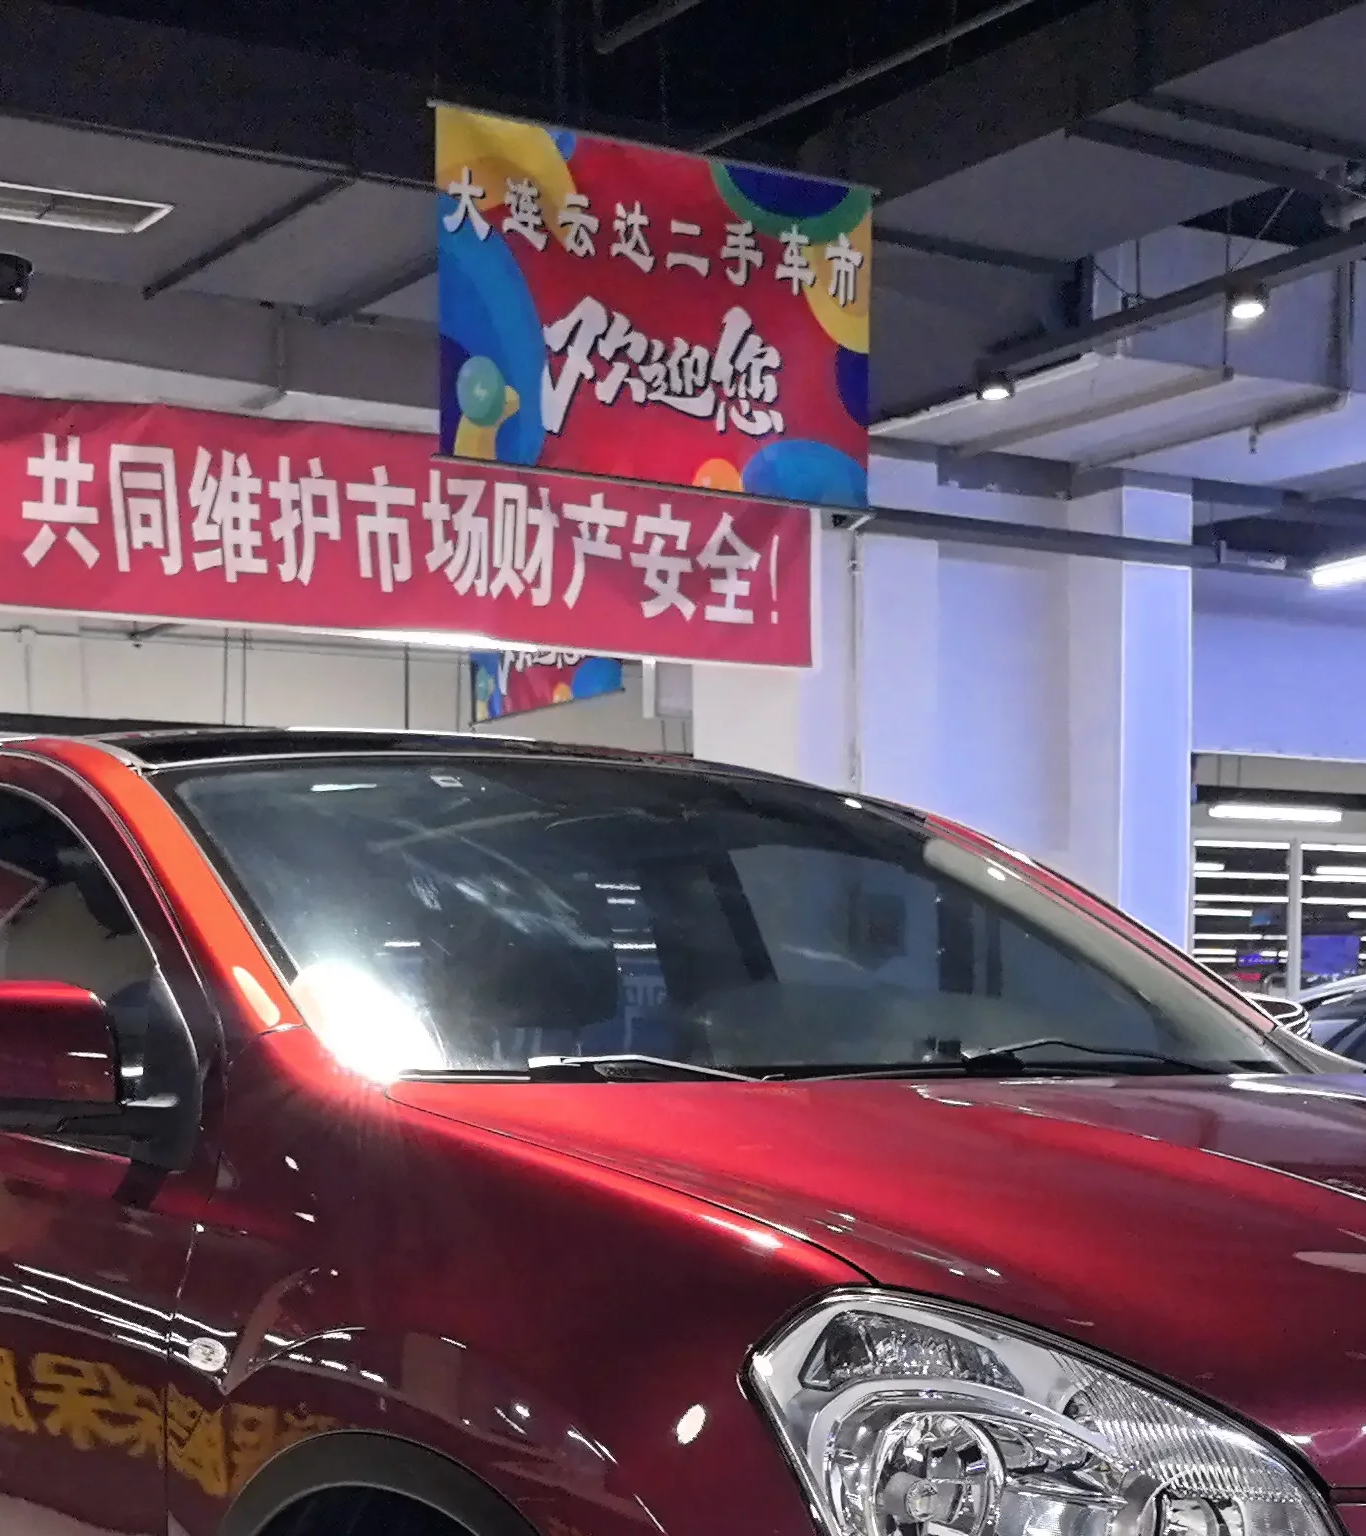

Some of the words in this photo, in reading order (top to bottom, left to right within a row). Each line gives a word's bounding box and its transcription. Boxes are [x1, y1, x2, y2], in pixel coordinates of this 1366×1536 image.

[443, 167, 864, 305] 大连云达二手车市
[542, 296, 786, 436] 欢迎您
